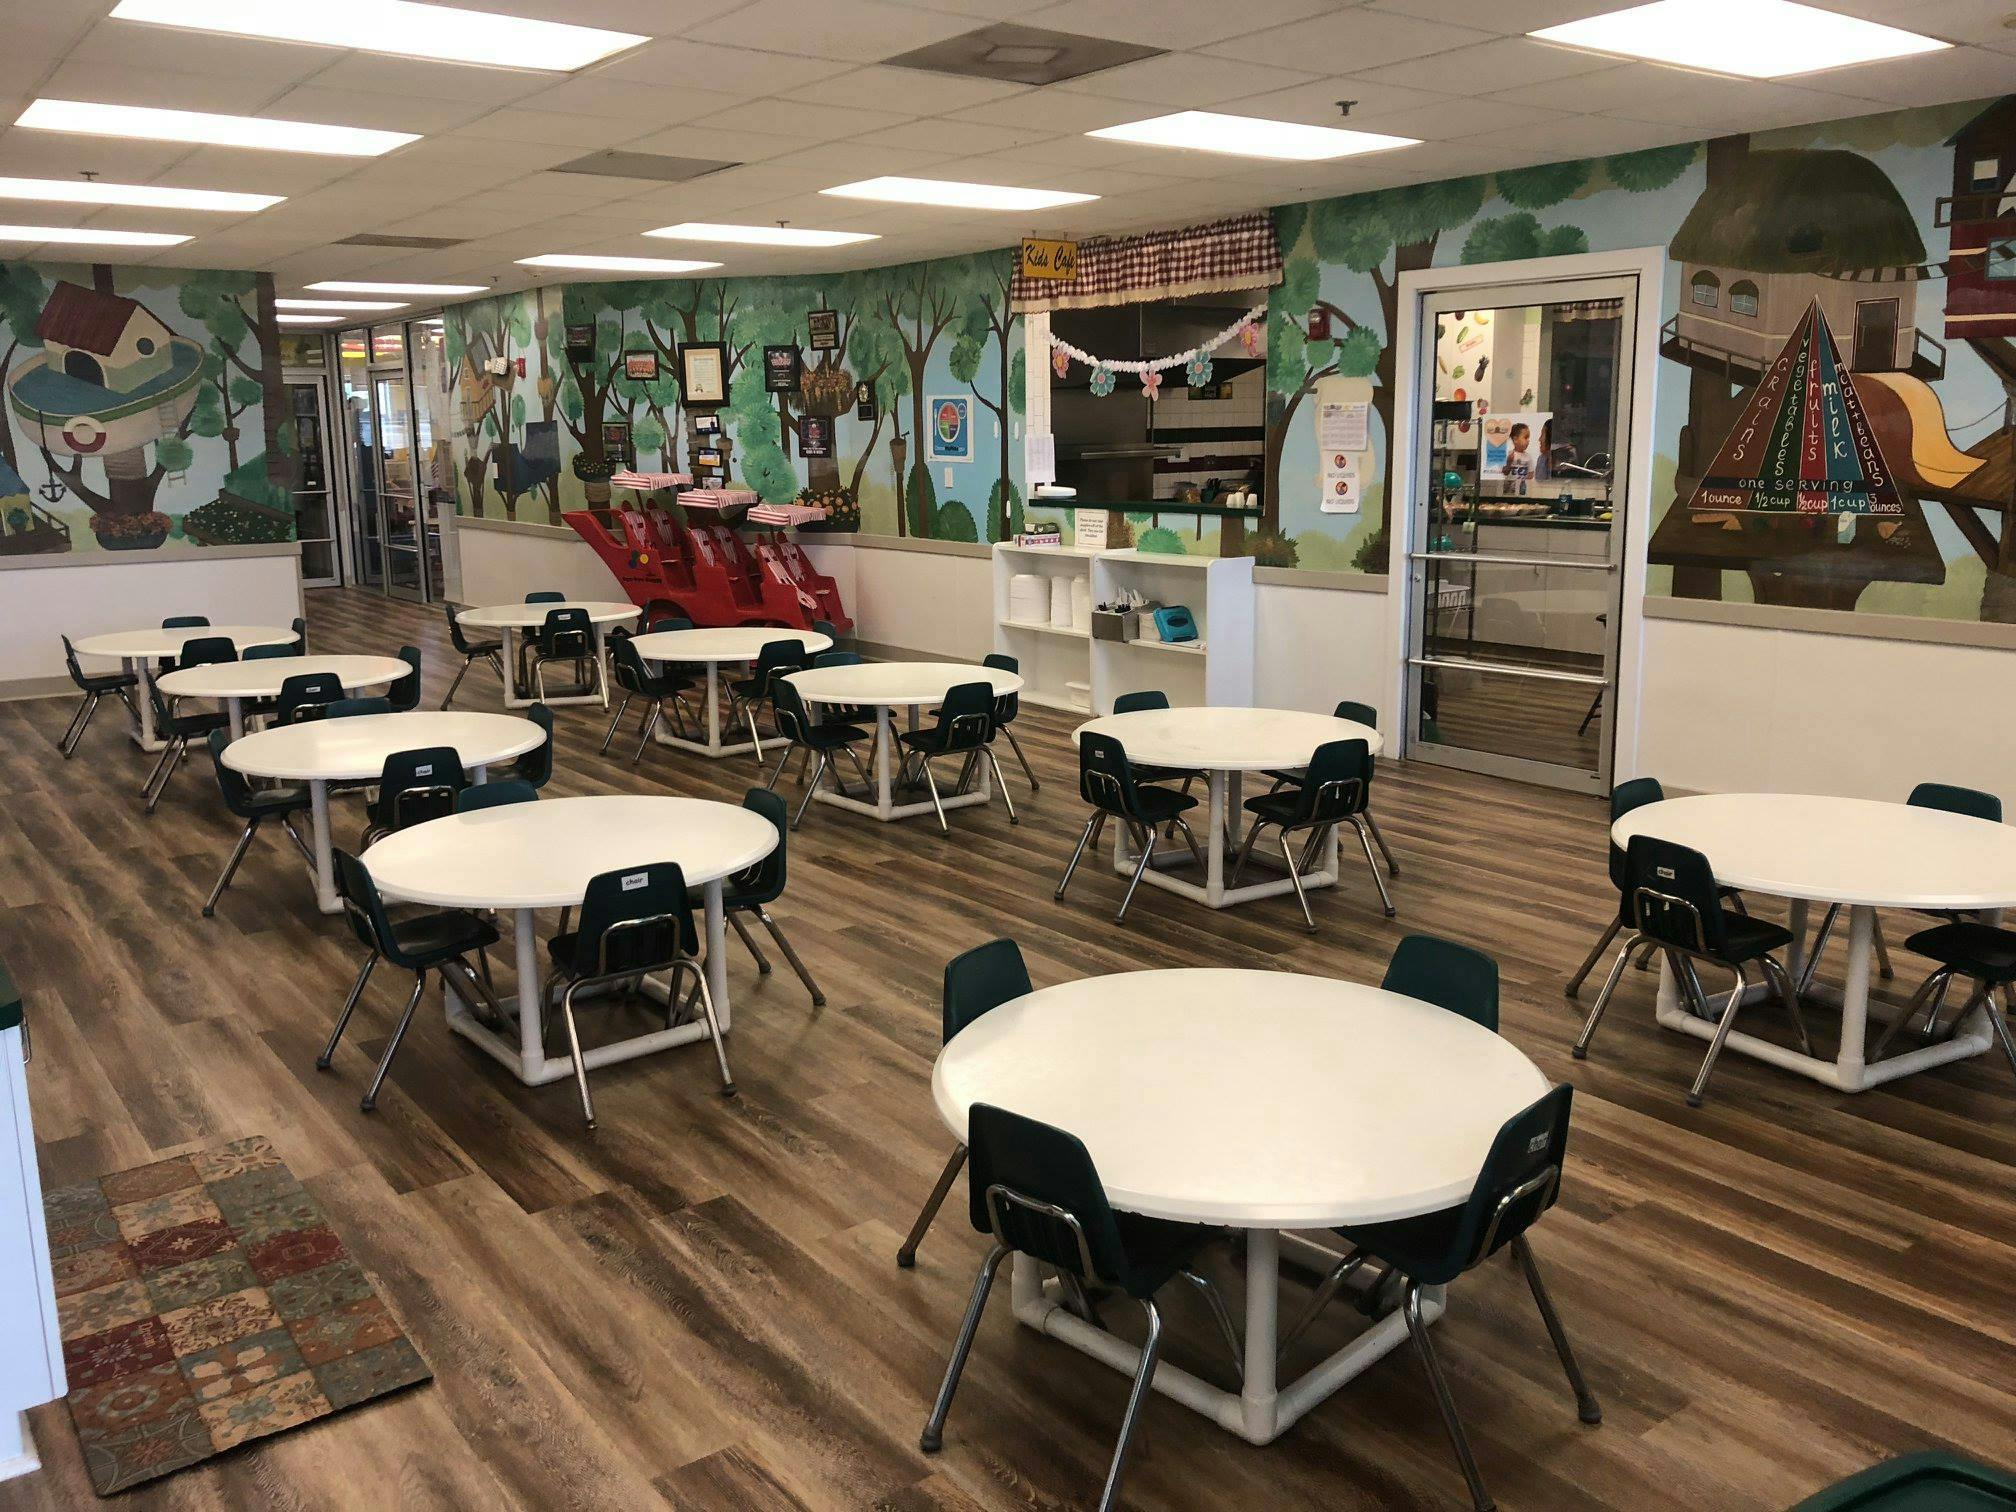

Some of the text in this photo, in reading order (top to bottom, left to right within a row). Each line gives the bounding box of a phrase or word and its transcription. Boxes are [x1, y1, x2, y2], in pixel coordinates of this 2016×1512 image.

[1025, 244, 1075, 276] Kids Cafe
[1808, 359, 1821, 461] fruits
[1739, 478, 1765, 489] one
[1870, 503, 1902, 513] ounces
[625, 877, 643, 886] chair
